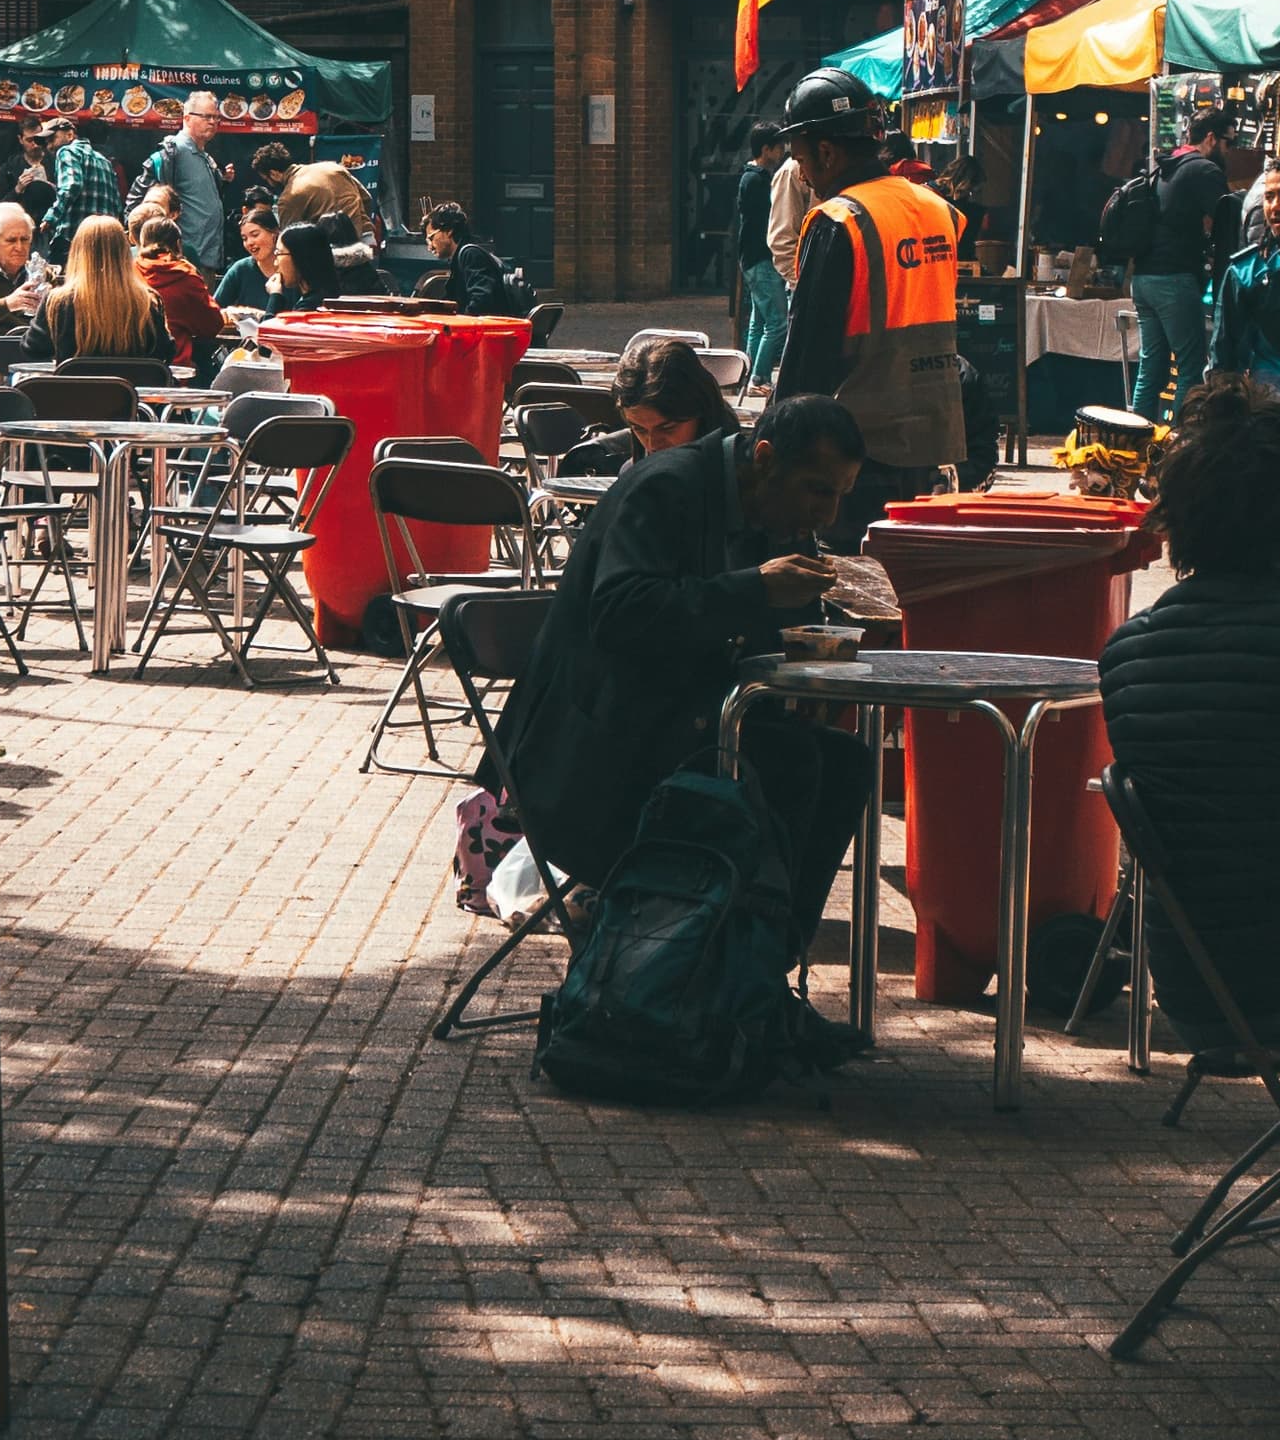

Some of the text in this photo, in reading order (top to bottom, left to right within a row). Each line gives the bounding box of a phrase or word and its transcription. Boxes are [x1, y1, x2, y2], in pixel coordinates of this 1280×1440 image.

[95, 66, 140, 81] INDIAN
[148, 69, 198, 85] NEPALESE
[202, 73, 241, 85] Cuisines
[910, 353, 960, 372] SMSTS
